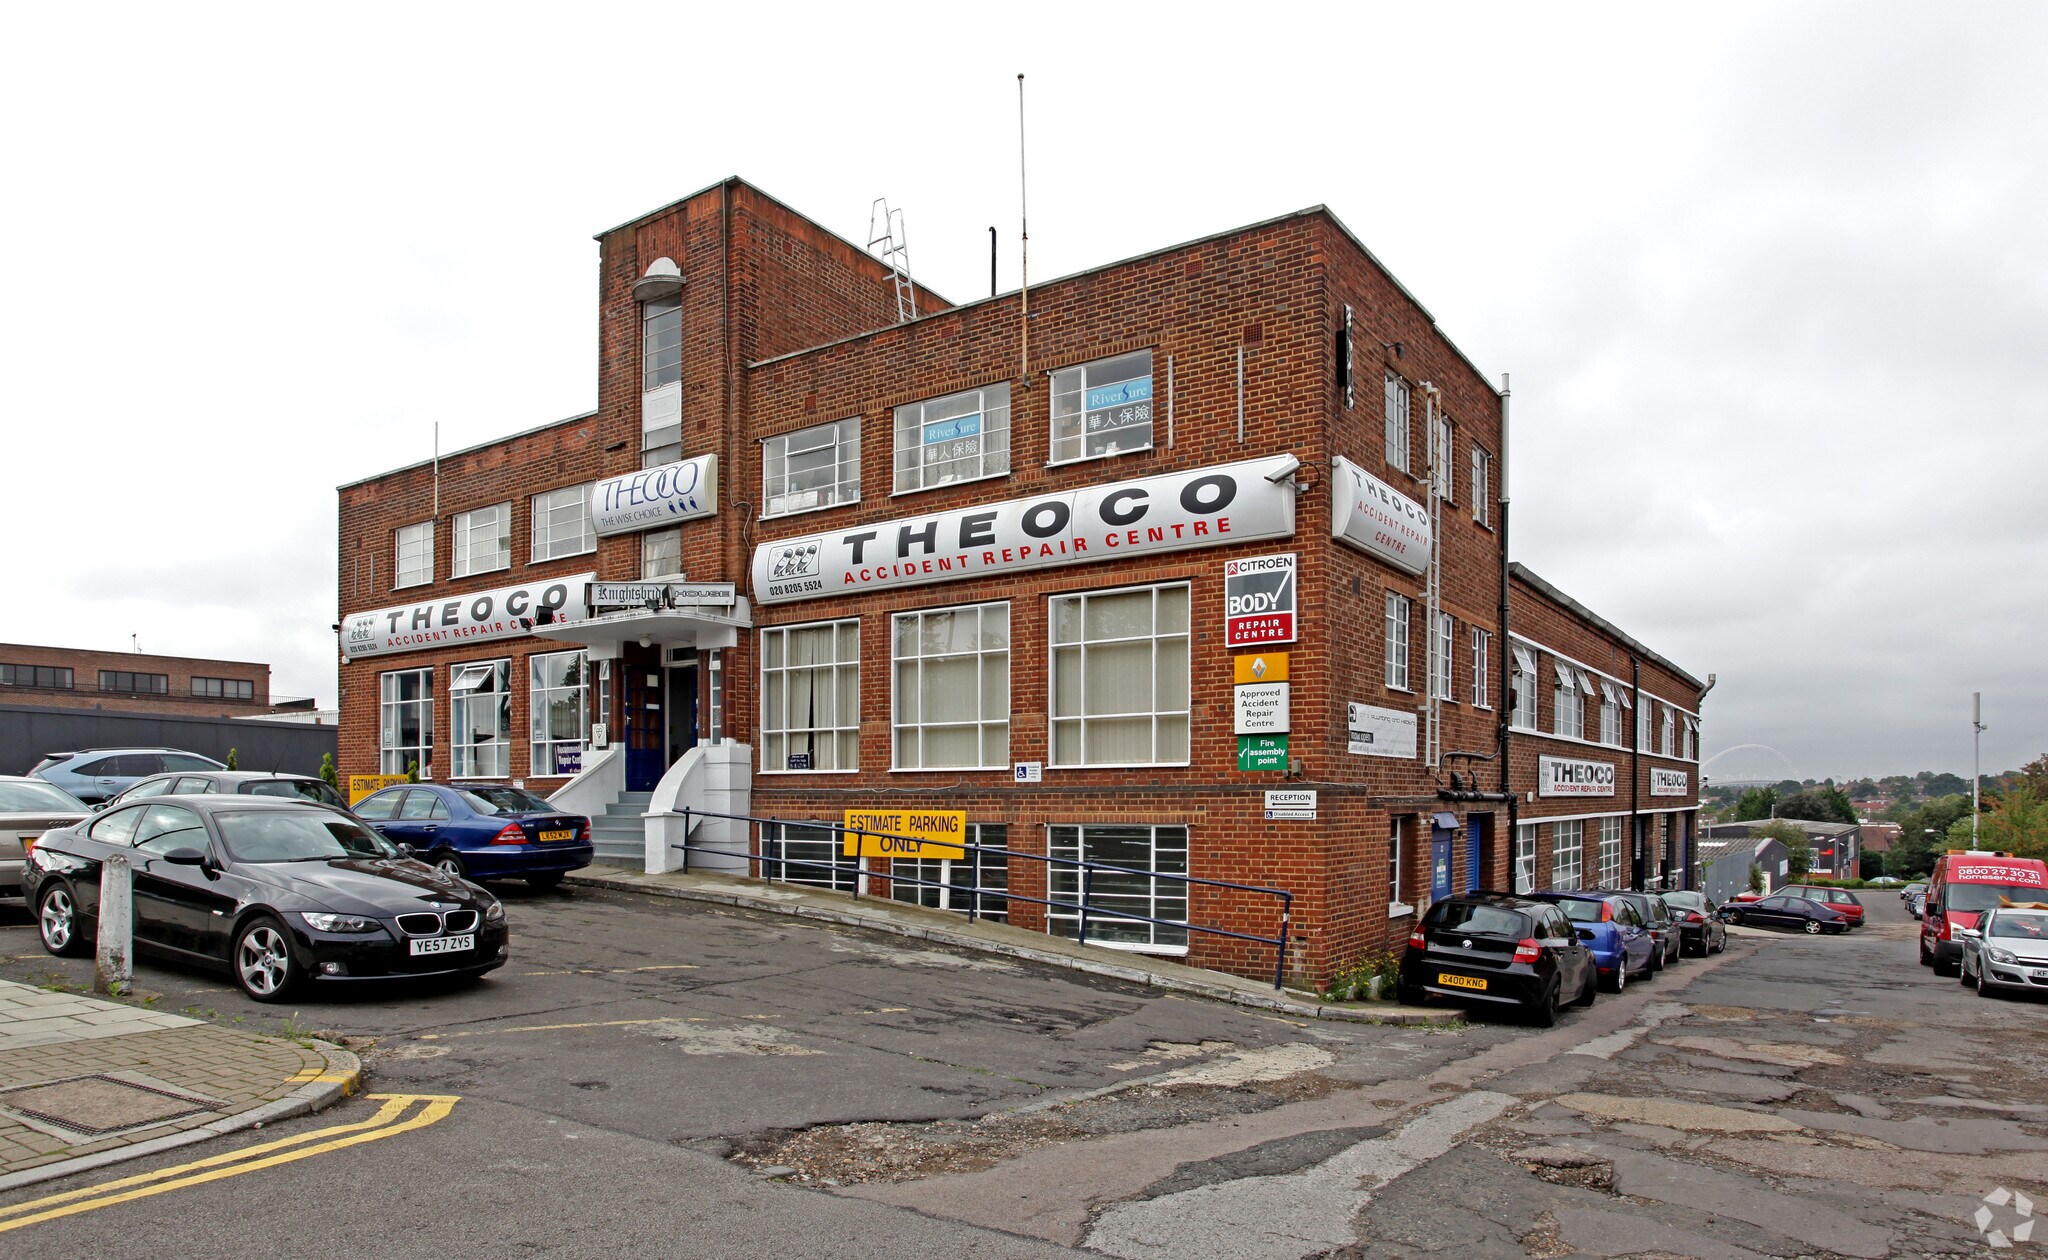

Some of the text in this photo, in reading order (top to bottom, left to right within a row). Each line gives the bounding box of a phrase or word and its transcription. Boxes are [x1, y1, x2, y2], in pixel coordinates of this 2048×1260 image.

[1091, 384, 1147, 406] RiverSure
[1089, 405, 1150, 430] 華人保險
[929, 420, 976, 440] RiverSure
[926, 440, 978, 461] 華人保險
[601, 462, 698, 511] THEOCO
[1352, 470, 1427, 526] THEOCO
[601, 507, 662, 527] THE WISE CHOICE
[843, 474, 1237, 565] THEOCO
[1358, 501, 1428, 546] ACCIDENT REPAIR
[844, 517, 1231, 584] ACCIDENT REPAIR CENTRE
[1375, 531, 1406, 553] CENTRE
[1240, 557, 1292, 572] CITROËN
[598, 584, 731, 603] Knightsbrid HOUSE
[769, 580, 823, 596] 020 8205 5524
[387, 584, 567, 634] THEOCO
[1239, 619, 1279, 630] REPAIR
[388, 630, 447, 647] ACCIDENT
[453, 622, 503, 637] REPAIR
[1235, 629, 1283, 640] CENTRE
[1240, 689, 1280, 699] Approved
[1246, 710, 1273, 718] Repair
[1250, 748, 1285, 757] assembly
[1258, 757, 1277, 765] point
[1551, 762, 1613, 784] THEOCO
[1656, 772, 1686, 787] THEOCO
[353, 779, 380, 791] ESTIMATE
[850, 815, 958, 832] ESTIMATE PARKING
[880, 836, 924, 853] ONLY
[1958, 874, 2041, 885] homeserve.com
[2029, 872, 2040, 880] 31
[416, 937, 470, 953] YE57 ZYS
[1442, 974, 1484, 988] S400 KNG
